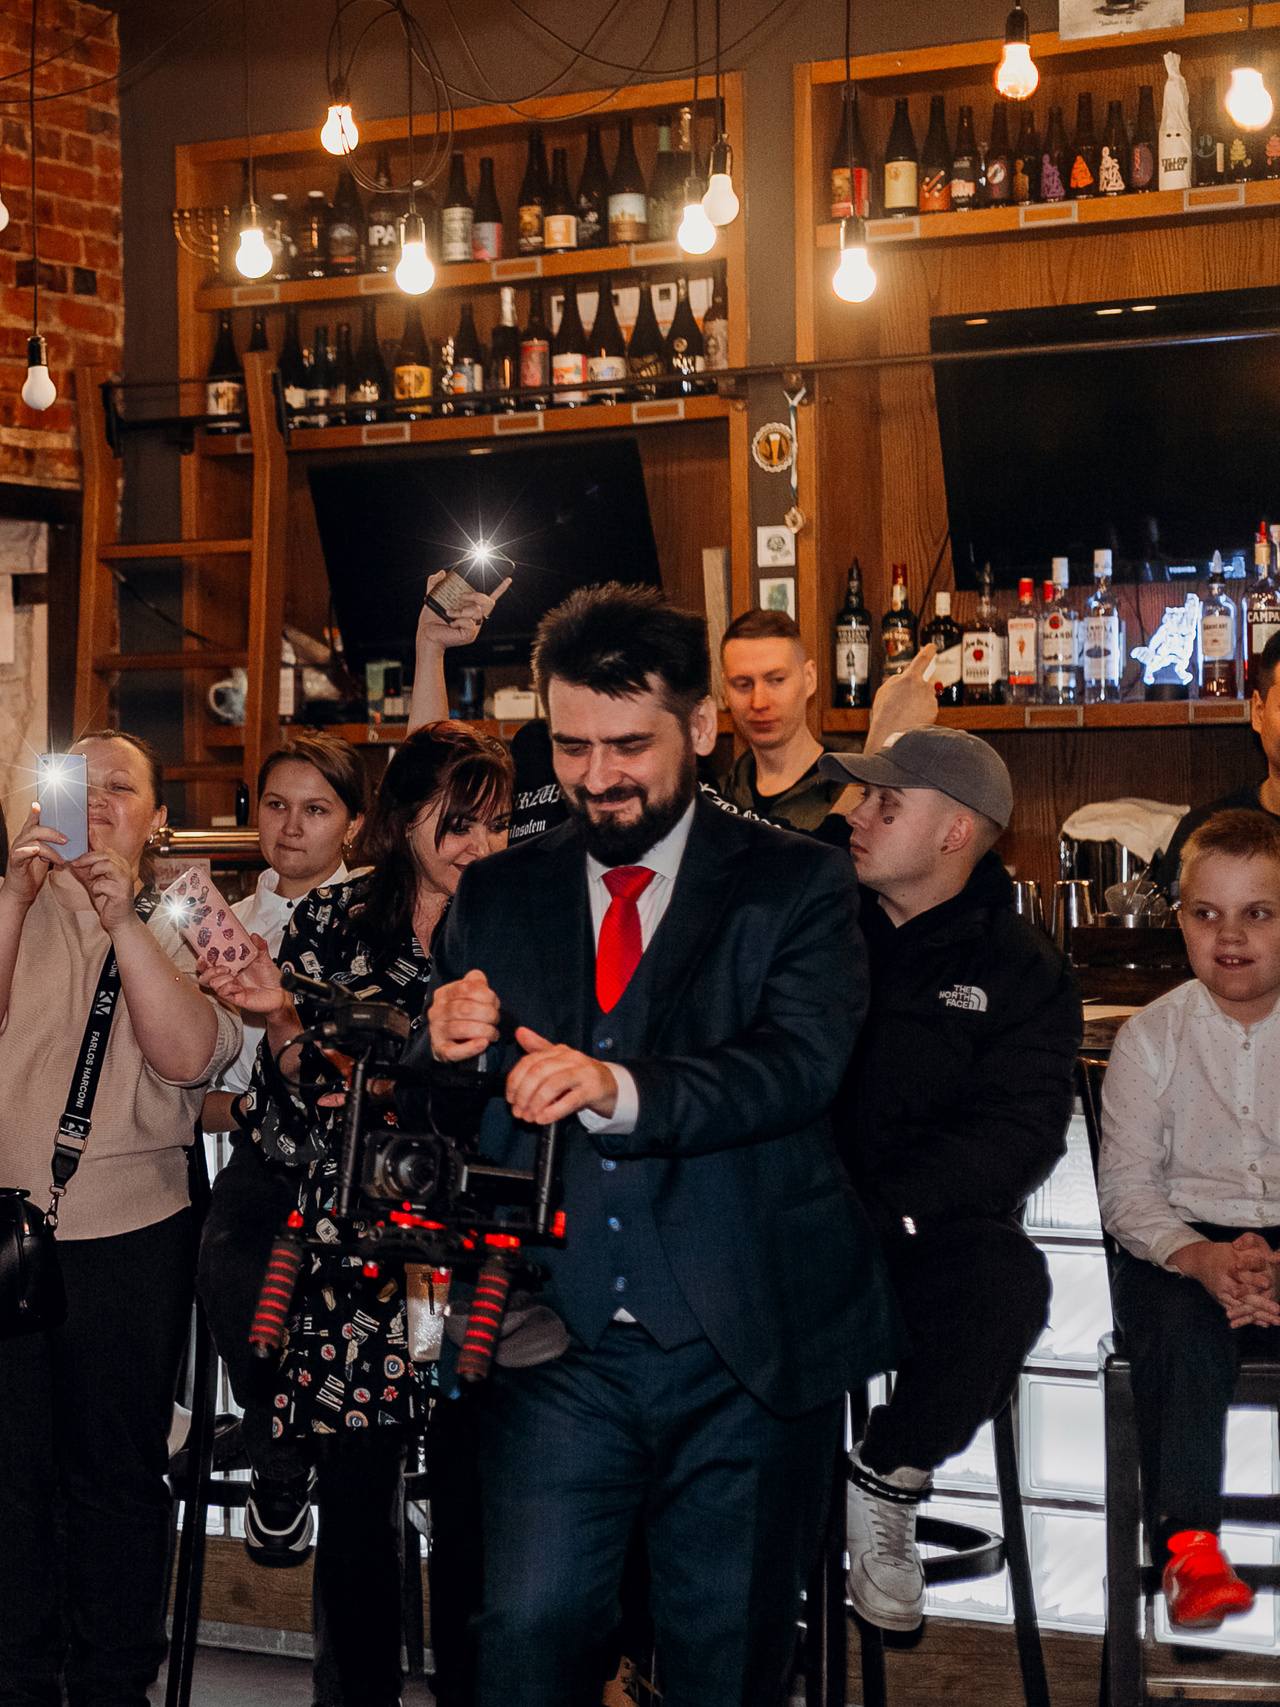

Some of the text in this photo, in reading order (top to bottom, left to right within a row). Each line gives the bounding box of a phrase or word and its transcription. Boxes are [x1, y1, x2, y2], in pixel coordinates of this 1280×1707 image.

[508, 819, 547, 839] ilosofem
[938, 991, 970, 1001] NORTH
[953, 984, 972, 994] THE
[945, 998, 970, 1010] FACE
[85, 1031, 101, 1066] FARLOS
[75, 1067, 92, 1109] HARCONI
